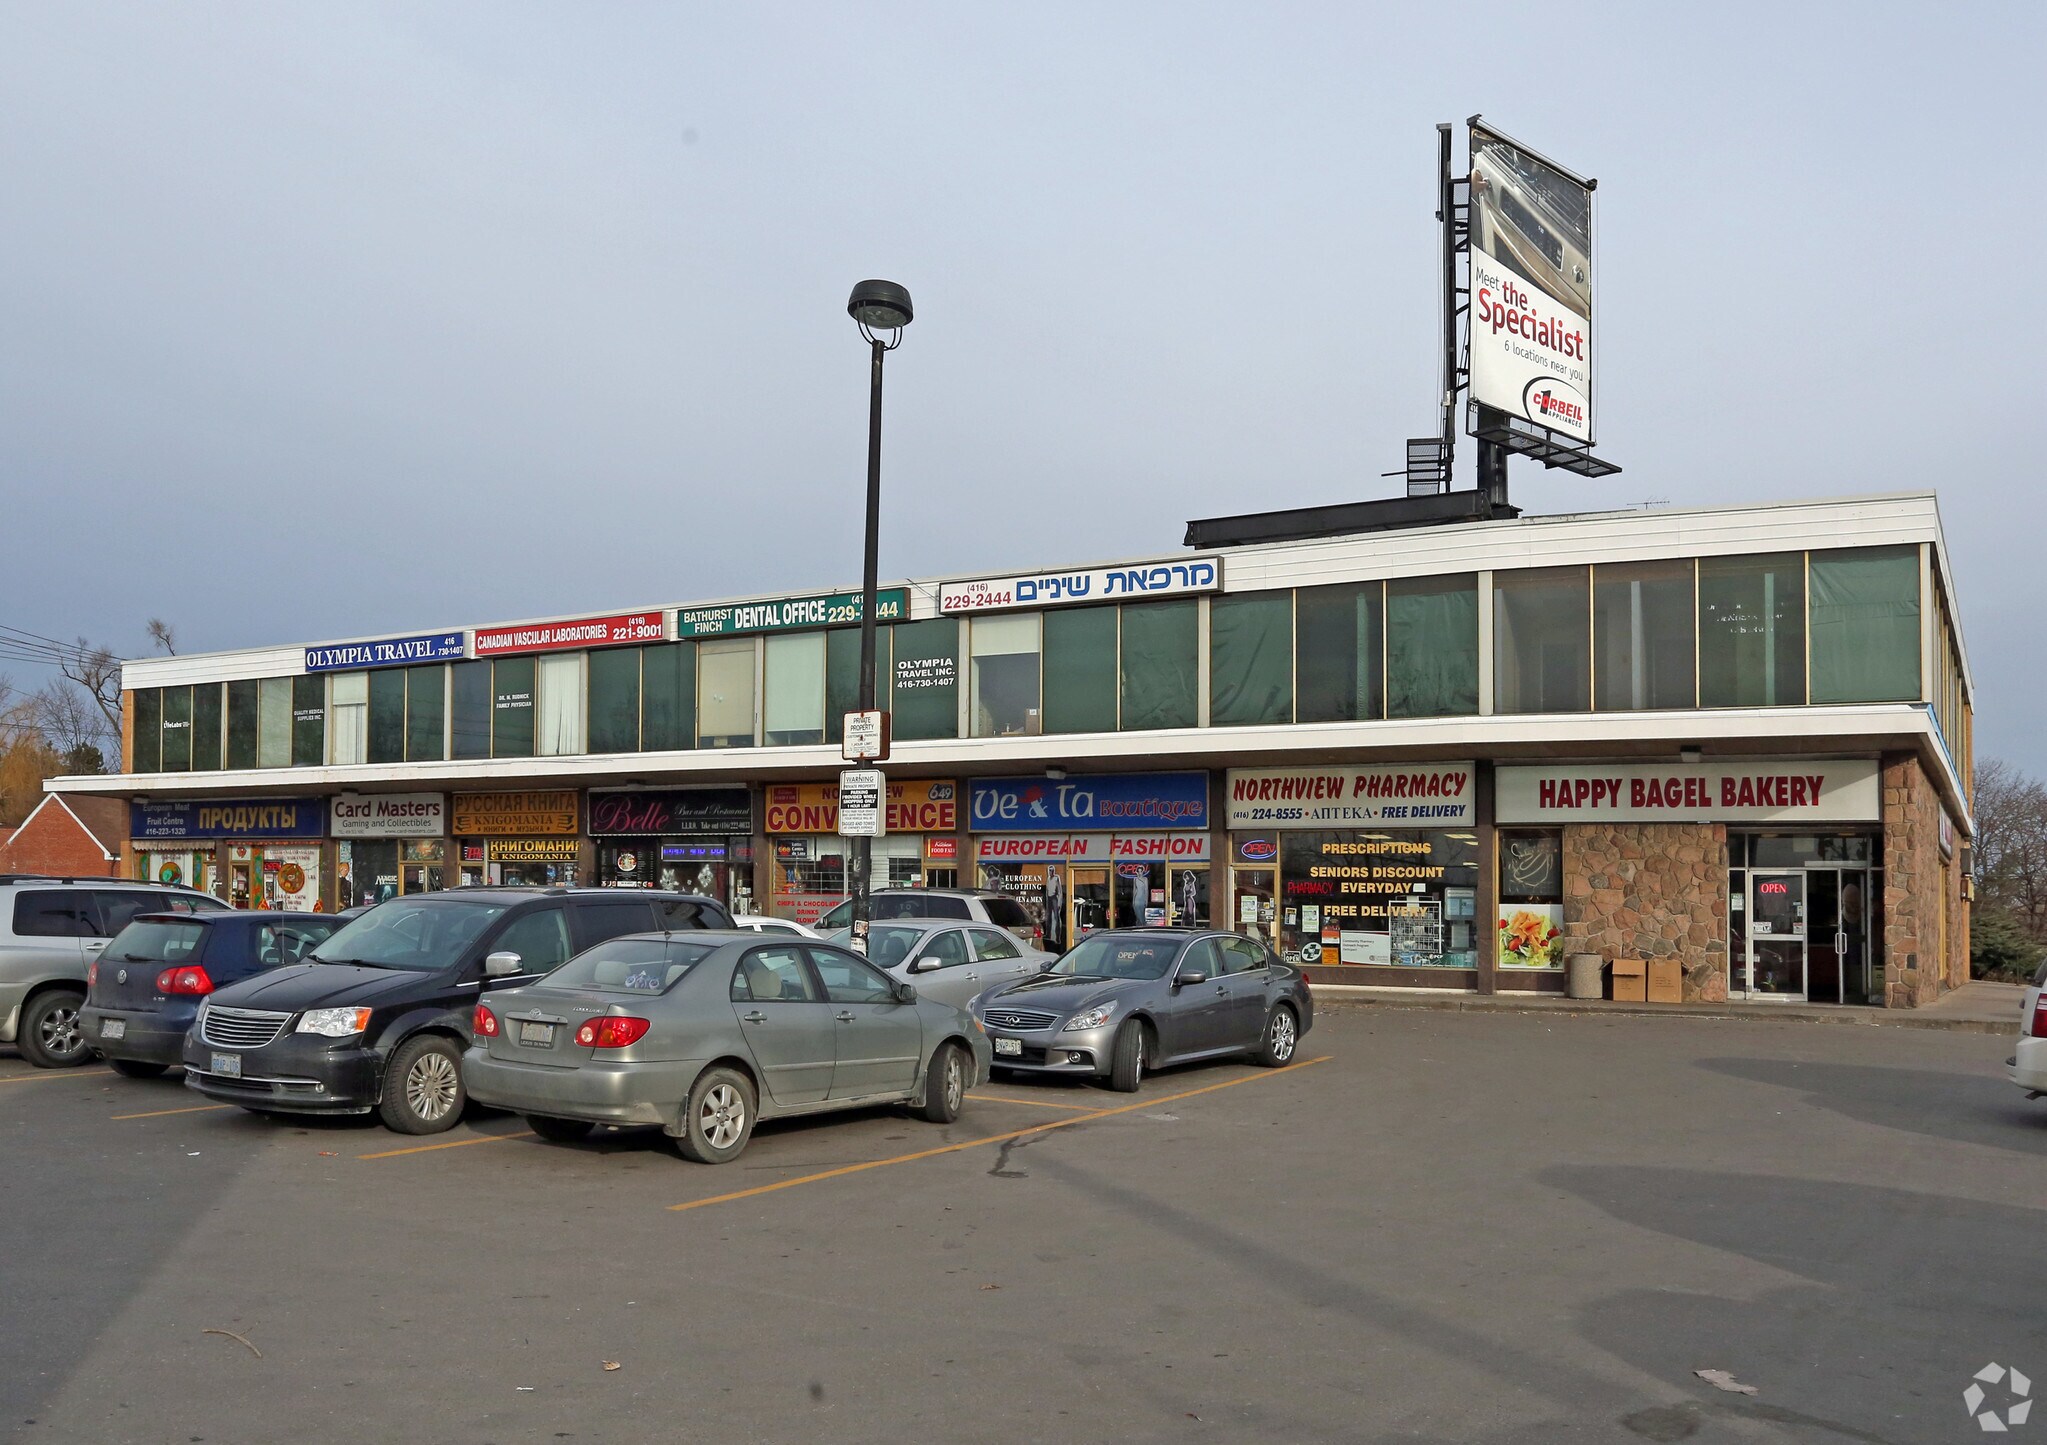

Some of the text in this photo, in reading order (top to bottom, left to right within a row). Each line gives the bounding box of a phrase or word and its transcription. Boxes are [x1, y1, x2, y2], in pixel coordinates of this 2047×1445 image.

[1476, 266, 1527, 310] Meet the
[1478, 288, 1583, 361] Specialist
[1504, 339, 1583, 382] 6 locations near you
[1548, 410, 1582, 428] APPLIANCES
[966, 583, 988, 594] (416)
[1016, 575, 1090, 601] שיניים
[944, 591, 1011, 609] 229-2444
[684, 608, 732, 623] BATHURST
[734, 605, 780, 629] DENTAL
[783, 600, 826, 625] OFFICE
[628, 617, 645, 626] (416)
[694, 620, 722, 633] FINCH
[444, 637, 455, 645] 416
[477, 624, 662, 650] CANADIAN VASCULAR LABORATORIES 221-9001
[306, 645, 373, 668] OLYMPIA
[374, 639, 436, 663] TRAVEL
[898, 657, 953, 669] OLYMPIA
[896, 667, 955, 678] TRAVEL INC.
[897, 678, 954, 688] 416-730-1407
[846, 775, 874, 783] WARNING
[1233, 772, 1467, 801] NORTHVIEW PHARMACY
[1539, 775, 1824, 809] HAPPY BAGEL BAKERY
[143, 802, 190, 814] European Meat
[335, 800, 440, 818] Card Masters
[456, 794, 575, 813] РУССКАЯ КНИГА
[709, 803, 749, 815] Restaurant
[594, 794, 669, 832] Belle
[767, 802, 955, 831] CONVENCE
[1233, 804, 1466, 820] (416) 224-8555 АПТЕКА FREE DELIVERY
[147, 817, 184, 826] Fruit Centre
[199, 806, 296, 831] ПРОДУКТЫ
[342, 818, 431, 830] Gaming and Collectibles
[474, 814, 553, 826] KNIGOMANIA
[145, 827, 186, 836] 416-223-1320
[980, 838, 1203, 856] EUROPEAN FASHION
[1244, 842, 1276, 854] OPEN
[1322, 842, 1432, 854] PRESCRIPTIONS
[1310, 866, 1444, 878] SENIORS DISCOUNT
[375, 875, 397, 885] MAGIC
[1288, 881, 1334, 895] PHARMACY
[1340, 882, 1412, 894] EVERYDAY
[1760, 883, 1787, 893] OPEN
[1323, 905, 1428, 917] FREE DELIVERY
[1285, 955, 1300, 963] OPEN
